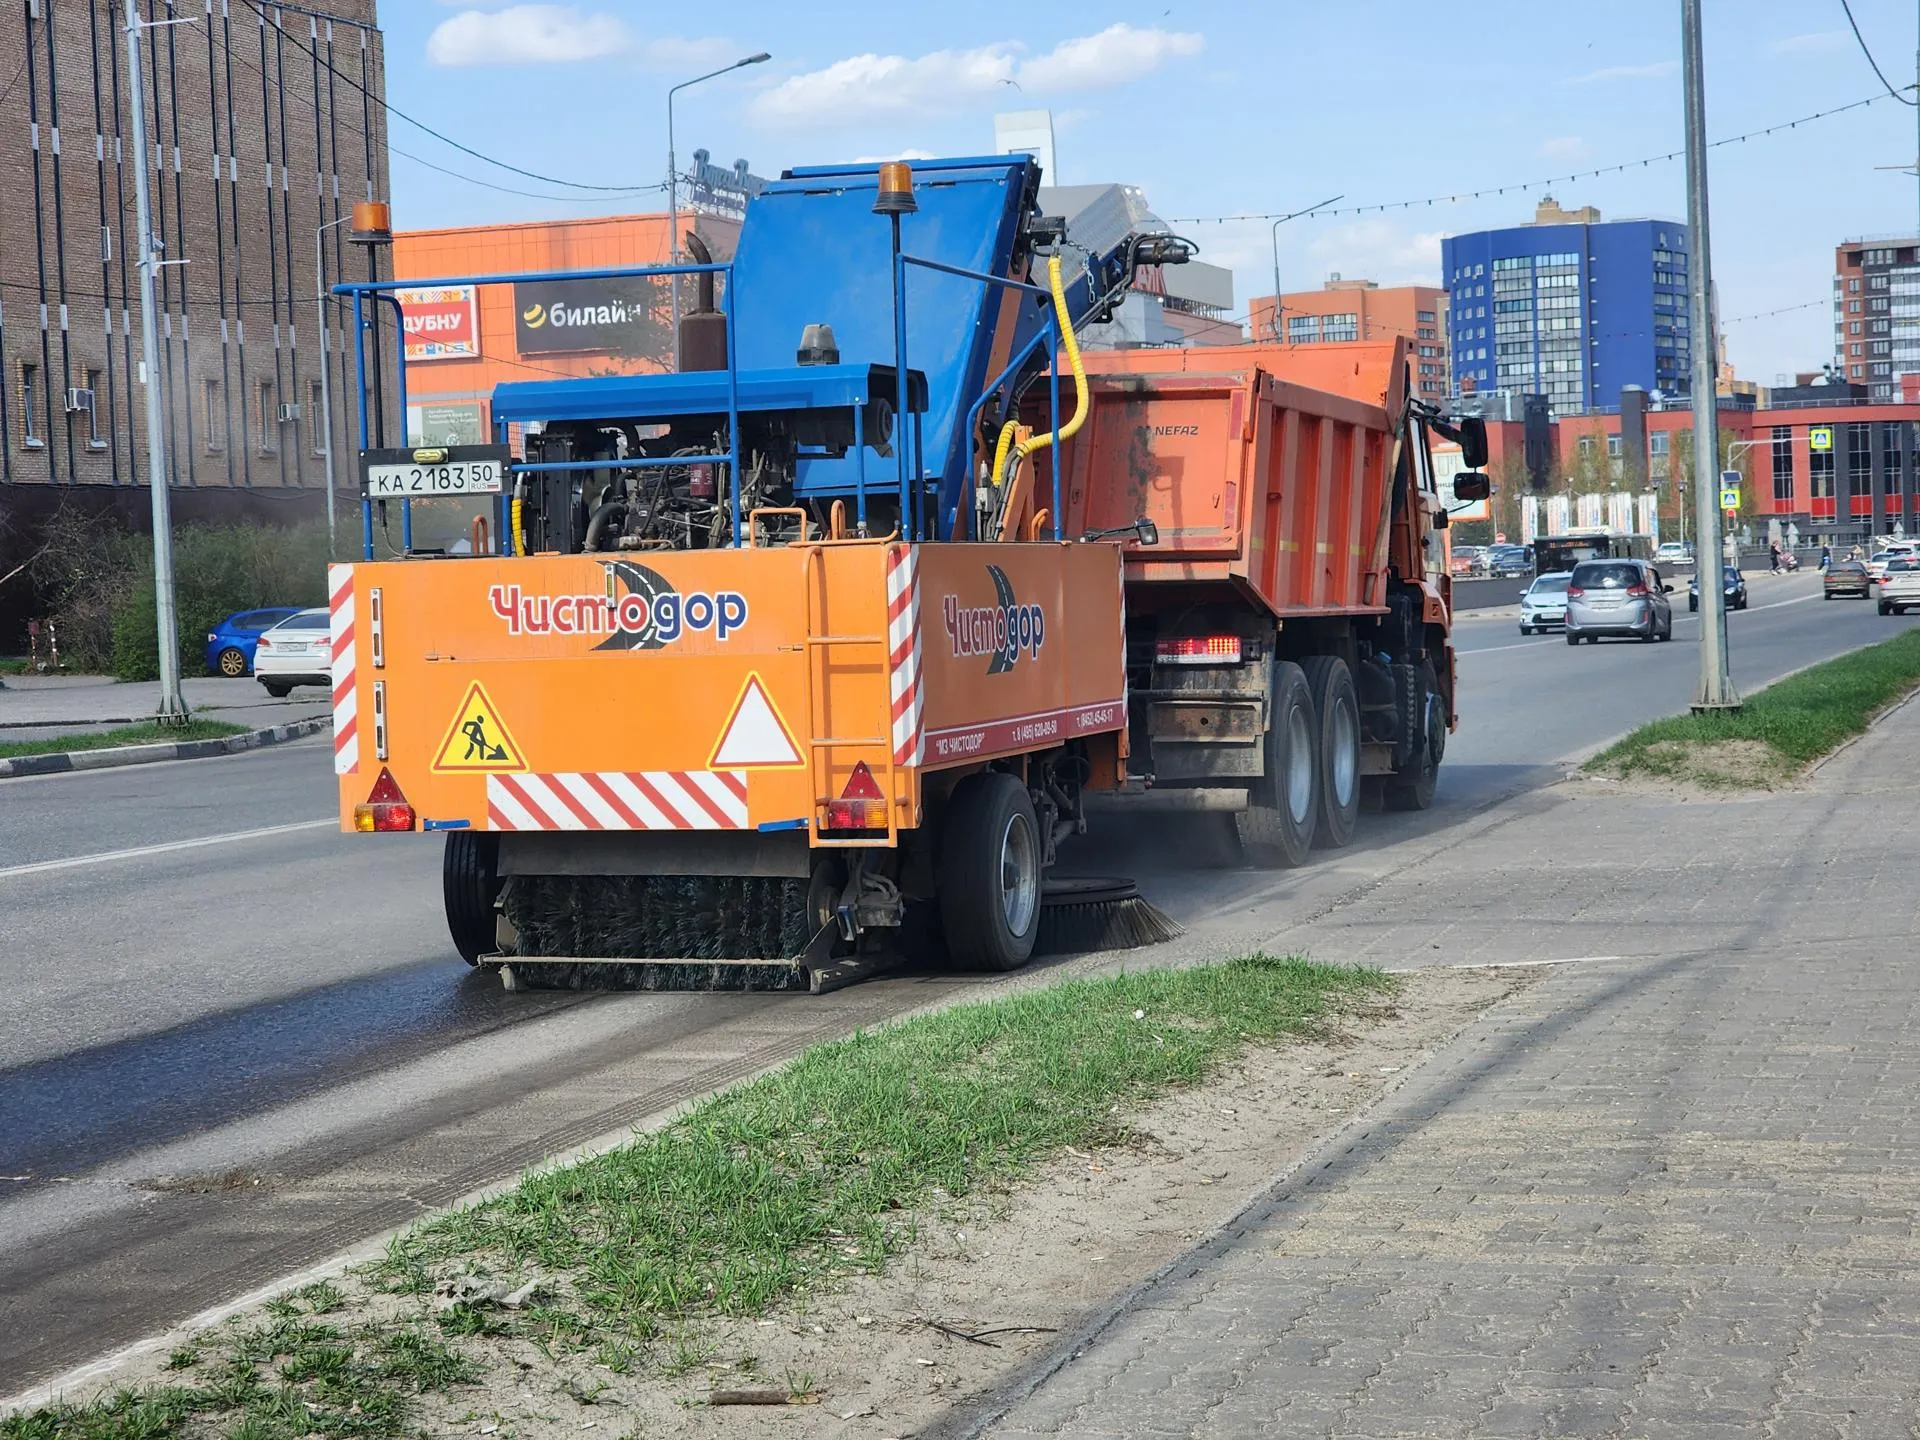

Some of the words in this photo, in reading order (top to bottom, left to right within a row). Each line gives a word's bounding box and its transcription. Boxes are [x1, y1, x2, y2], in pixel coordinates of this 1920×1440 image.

[1155, 425, 1199, 436] NEFAZ
[410, 467, 465, 491] 2183
[471, 464, 493, 482] 50
[471, 482, 487, 490] RUS
[488, 583, 749, 642] Чистодор
[943, 593, 1045, 664] Чистодор
